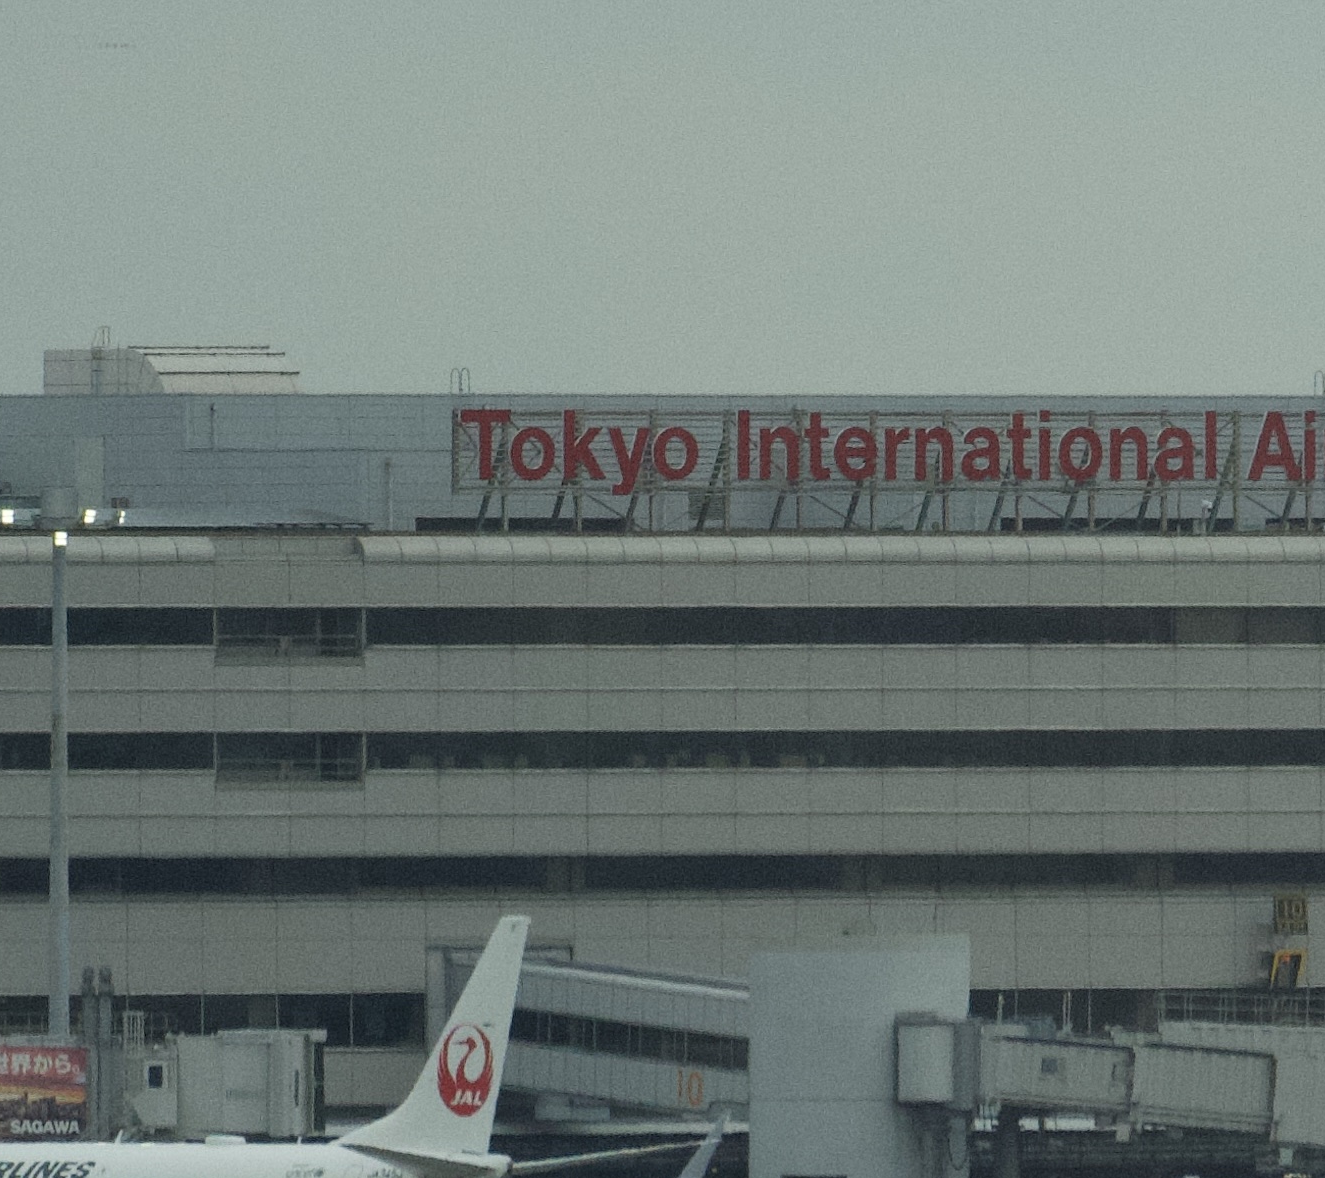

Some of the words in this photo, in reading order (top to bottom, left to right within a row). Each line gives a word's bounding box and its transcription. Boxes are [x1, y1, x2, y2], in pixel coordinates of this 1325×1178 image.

[460, 409, 700, 494] Tokyo
[737, 408, 1217, 482] International
[450, 1089, 483, 1106] JAL
[11, 1120, 80, 1135] SAGAWA
